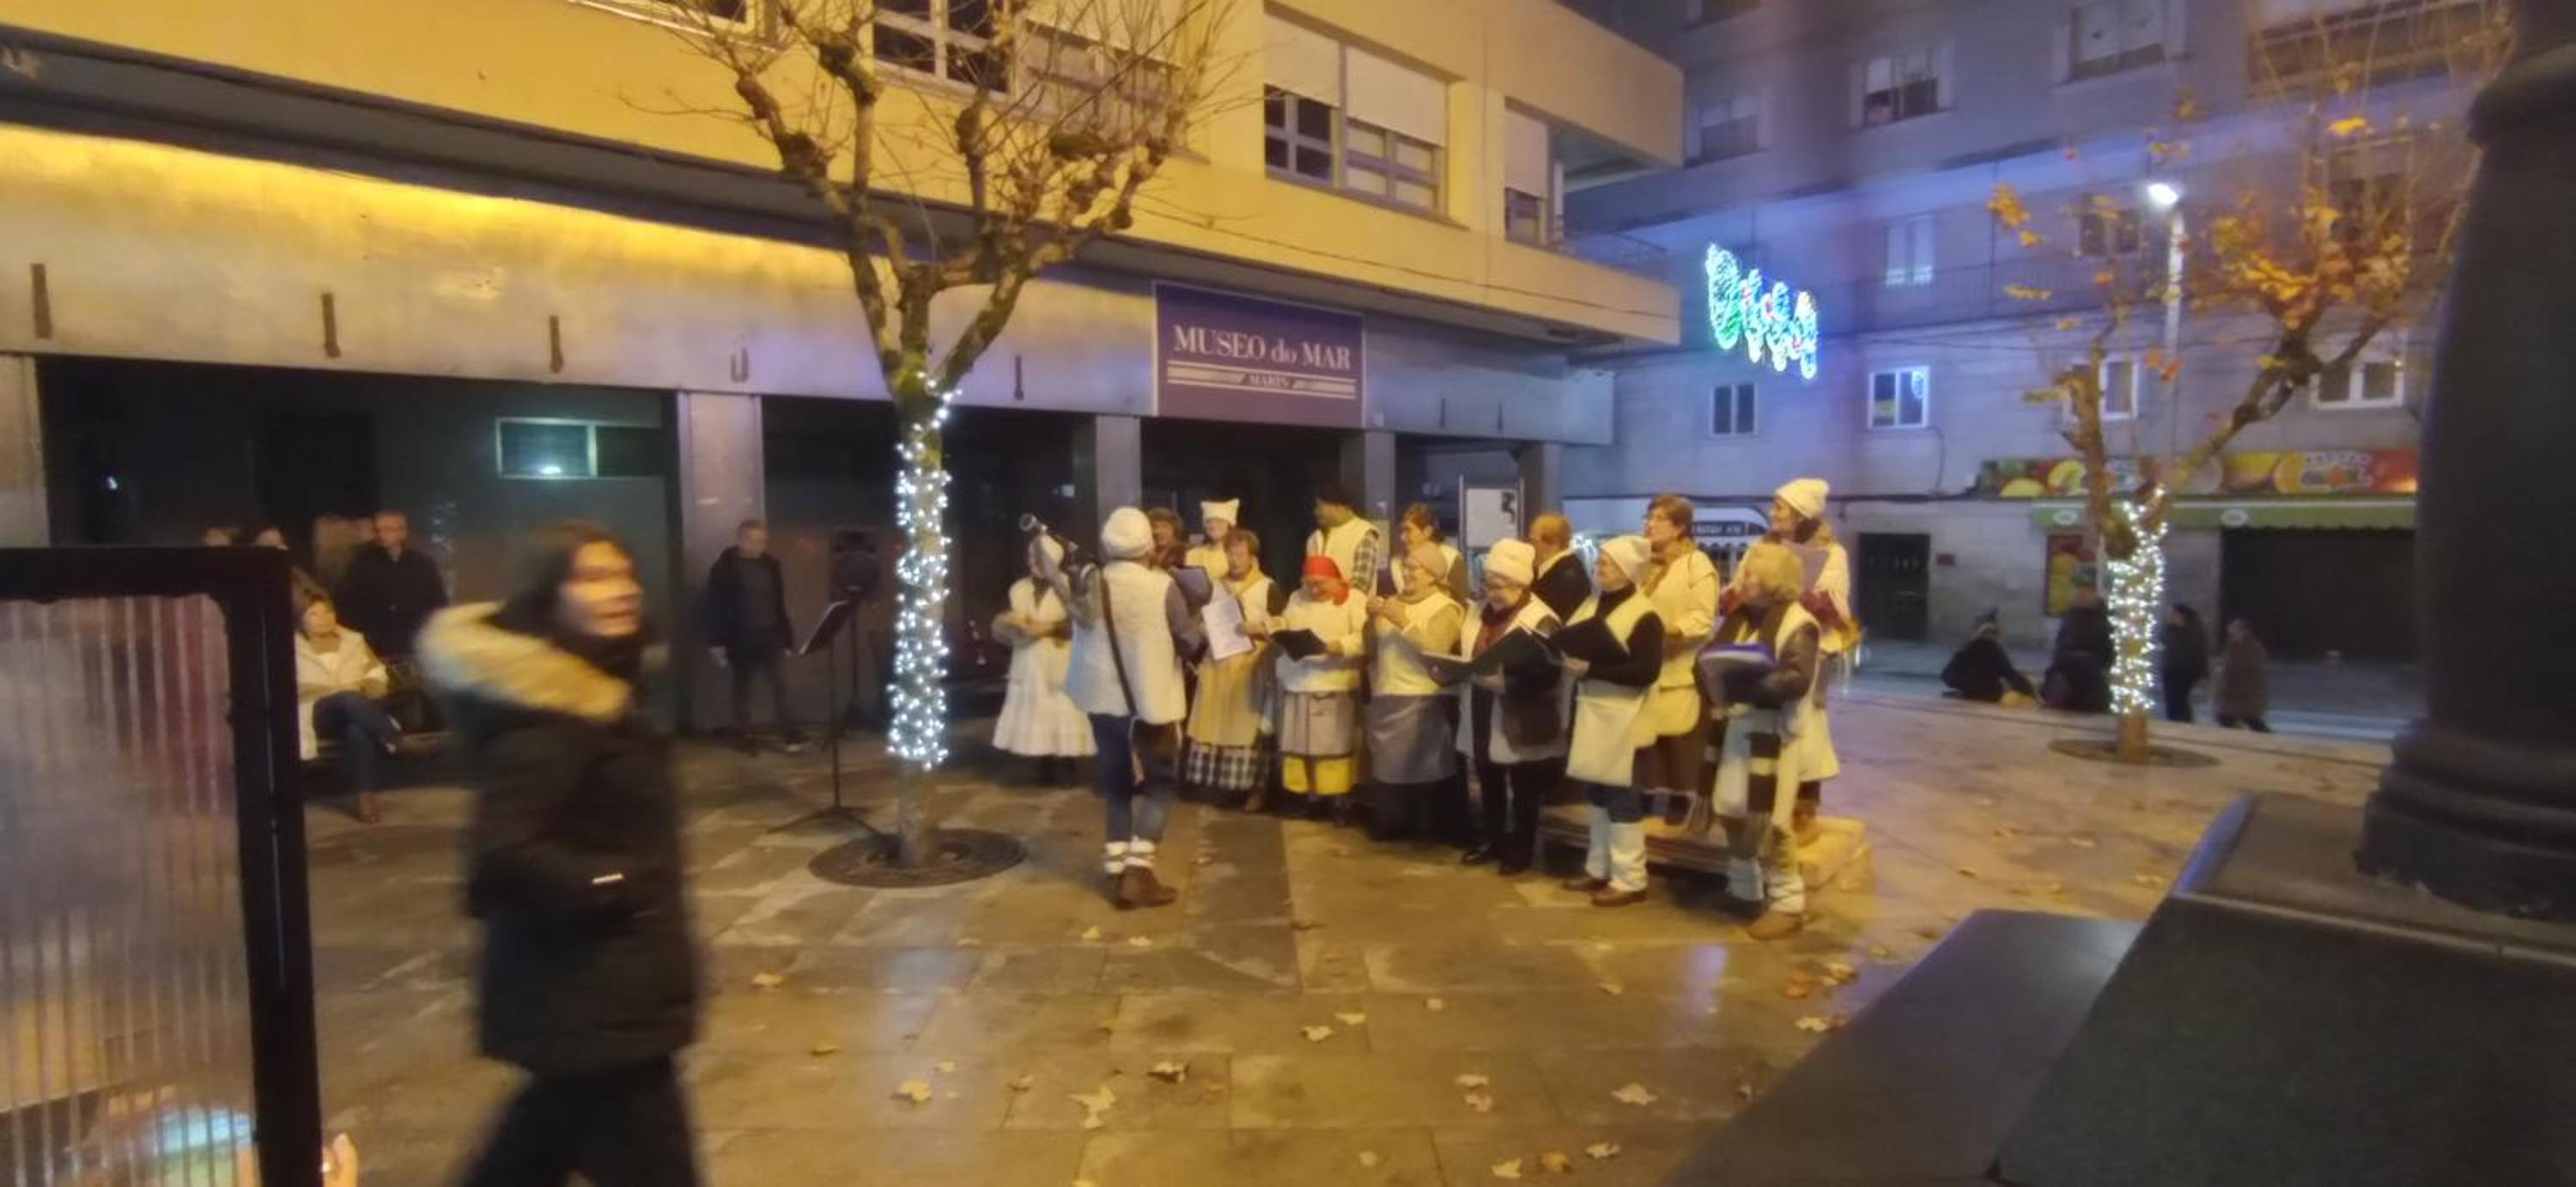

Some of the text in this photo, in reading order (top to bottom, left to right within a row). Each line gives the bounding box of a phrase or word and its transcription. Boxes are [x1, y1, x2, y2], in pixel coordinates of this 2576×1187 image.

[1173, 324, 1352, 370] MUSEO do MAR
